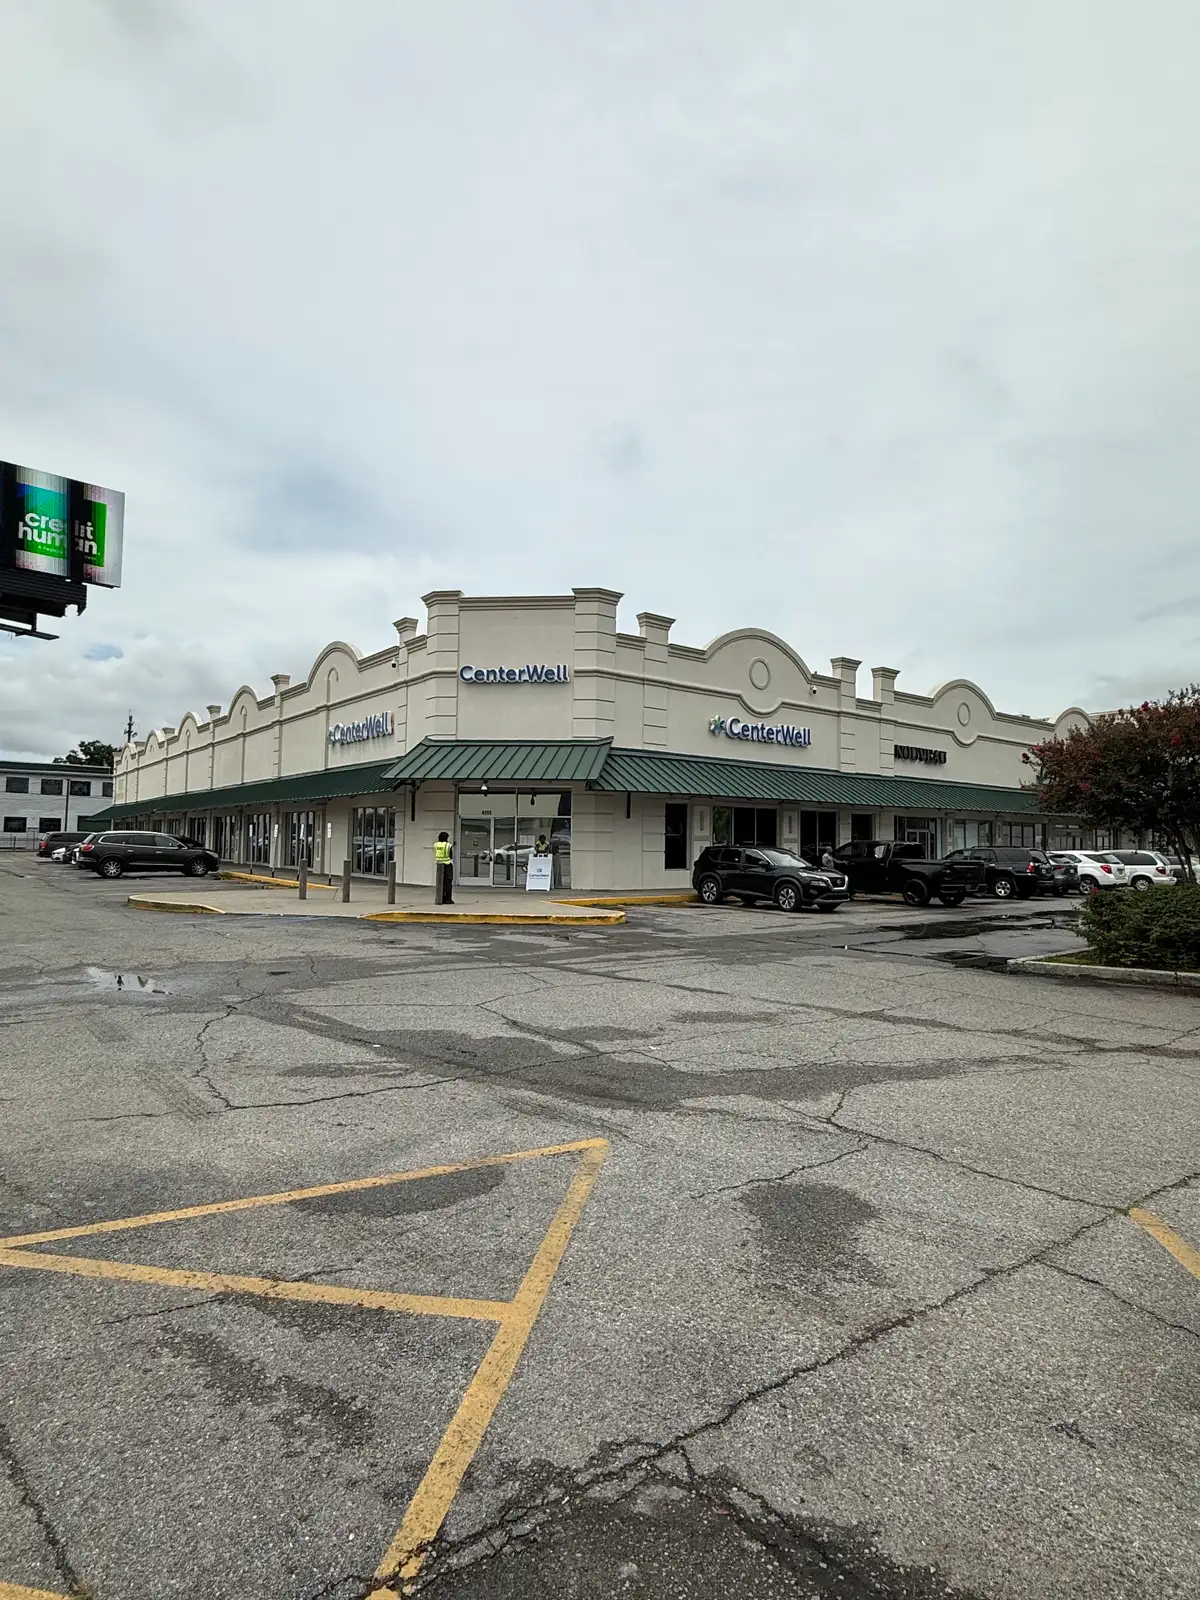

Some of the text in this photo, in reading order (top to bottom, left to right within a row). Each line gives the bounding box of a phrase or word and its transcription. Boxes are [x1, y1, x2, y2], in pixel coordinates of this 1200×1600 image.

[25, 512, 94, 540] creit
[460, 664, 569, 683] CenterWell
[334, 711, 391, 744] CenterWell
[726, 717, 812, 747] CenterWell
[894, 744, 948, 765] NOUVEAU
